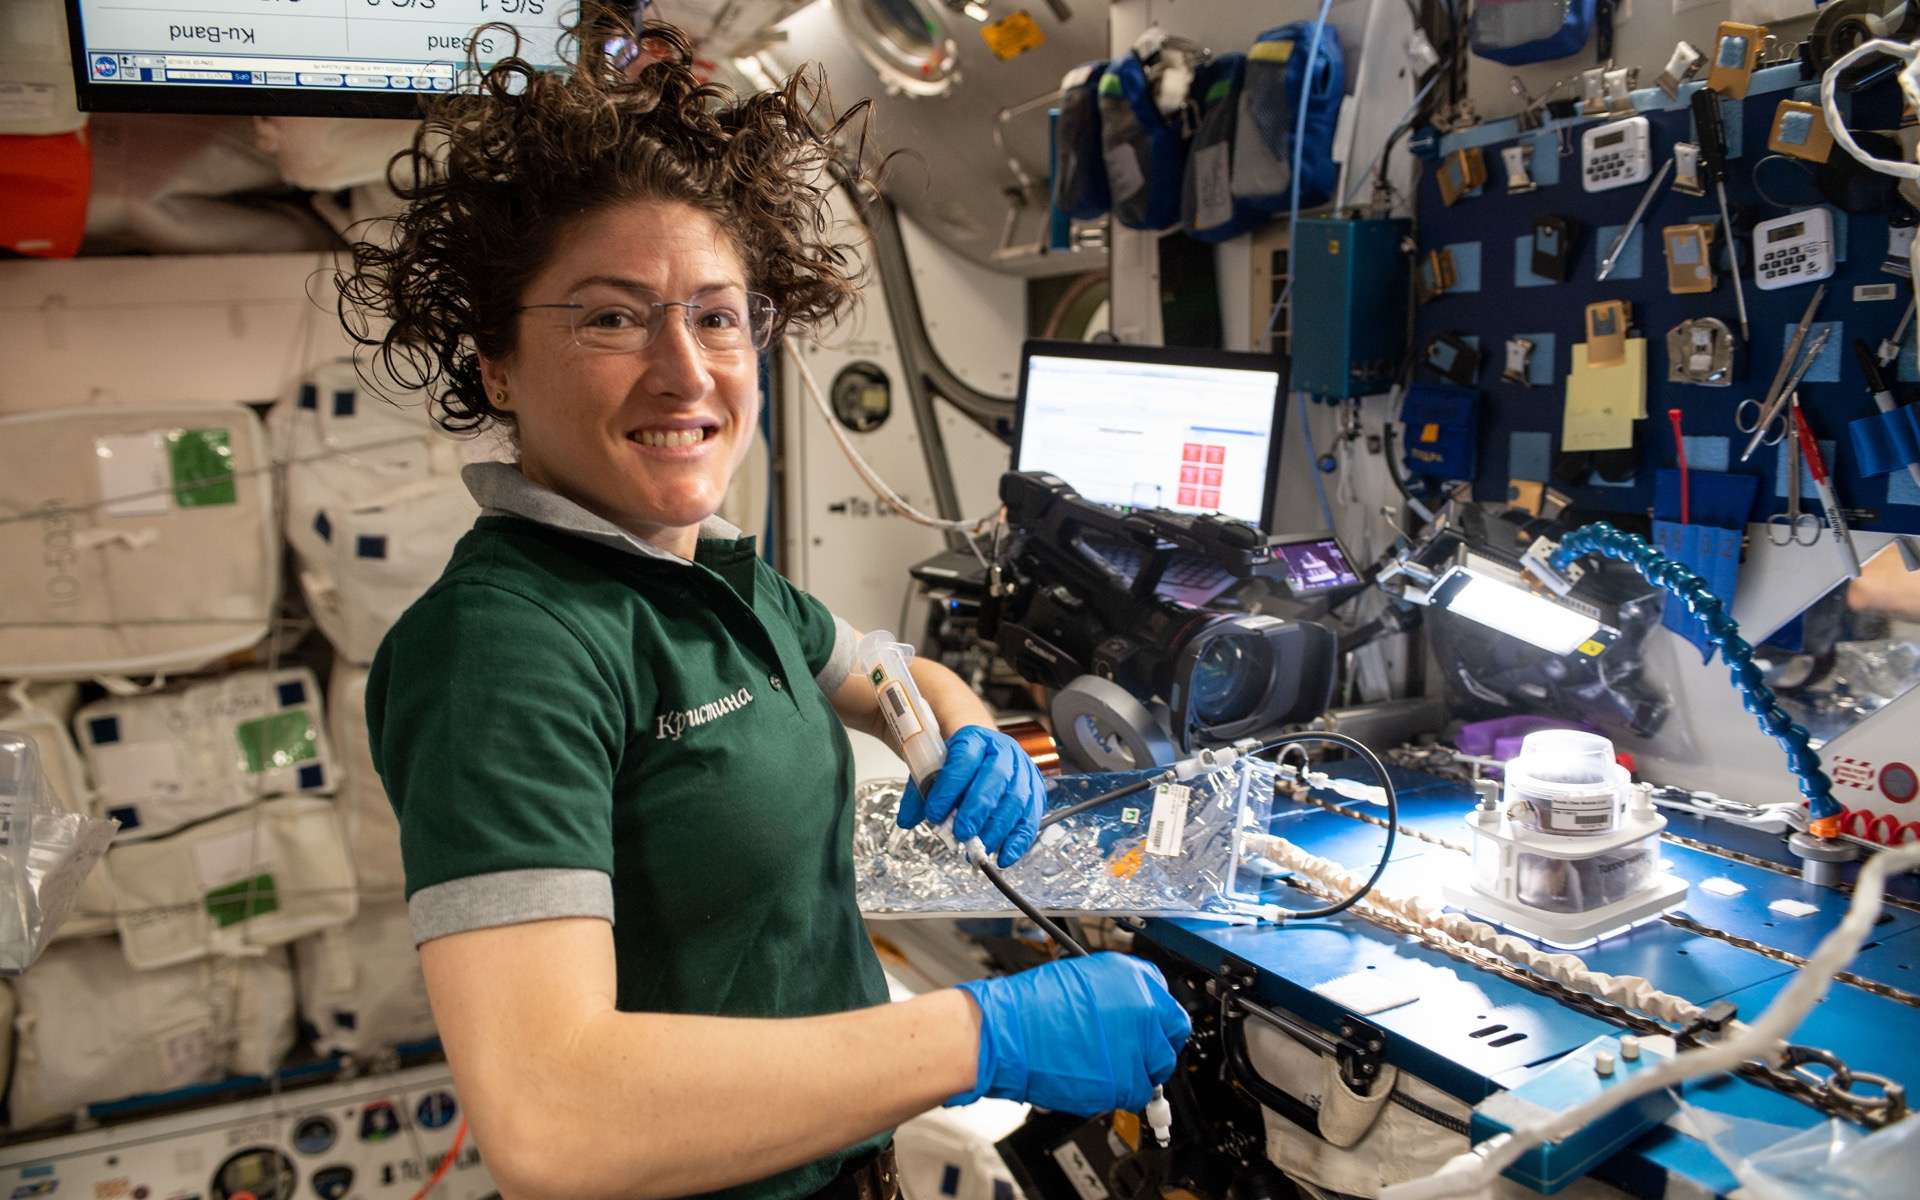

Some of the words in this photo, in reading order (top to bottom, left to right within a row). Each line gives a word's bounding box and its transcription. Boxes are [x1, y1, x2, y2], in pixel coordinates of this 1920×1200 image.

[169, 24, 255, 45] Ku-Band
[427, 35, 495, 54] S-Band
[656, 687, 753, 740] Кристина
